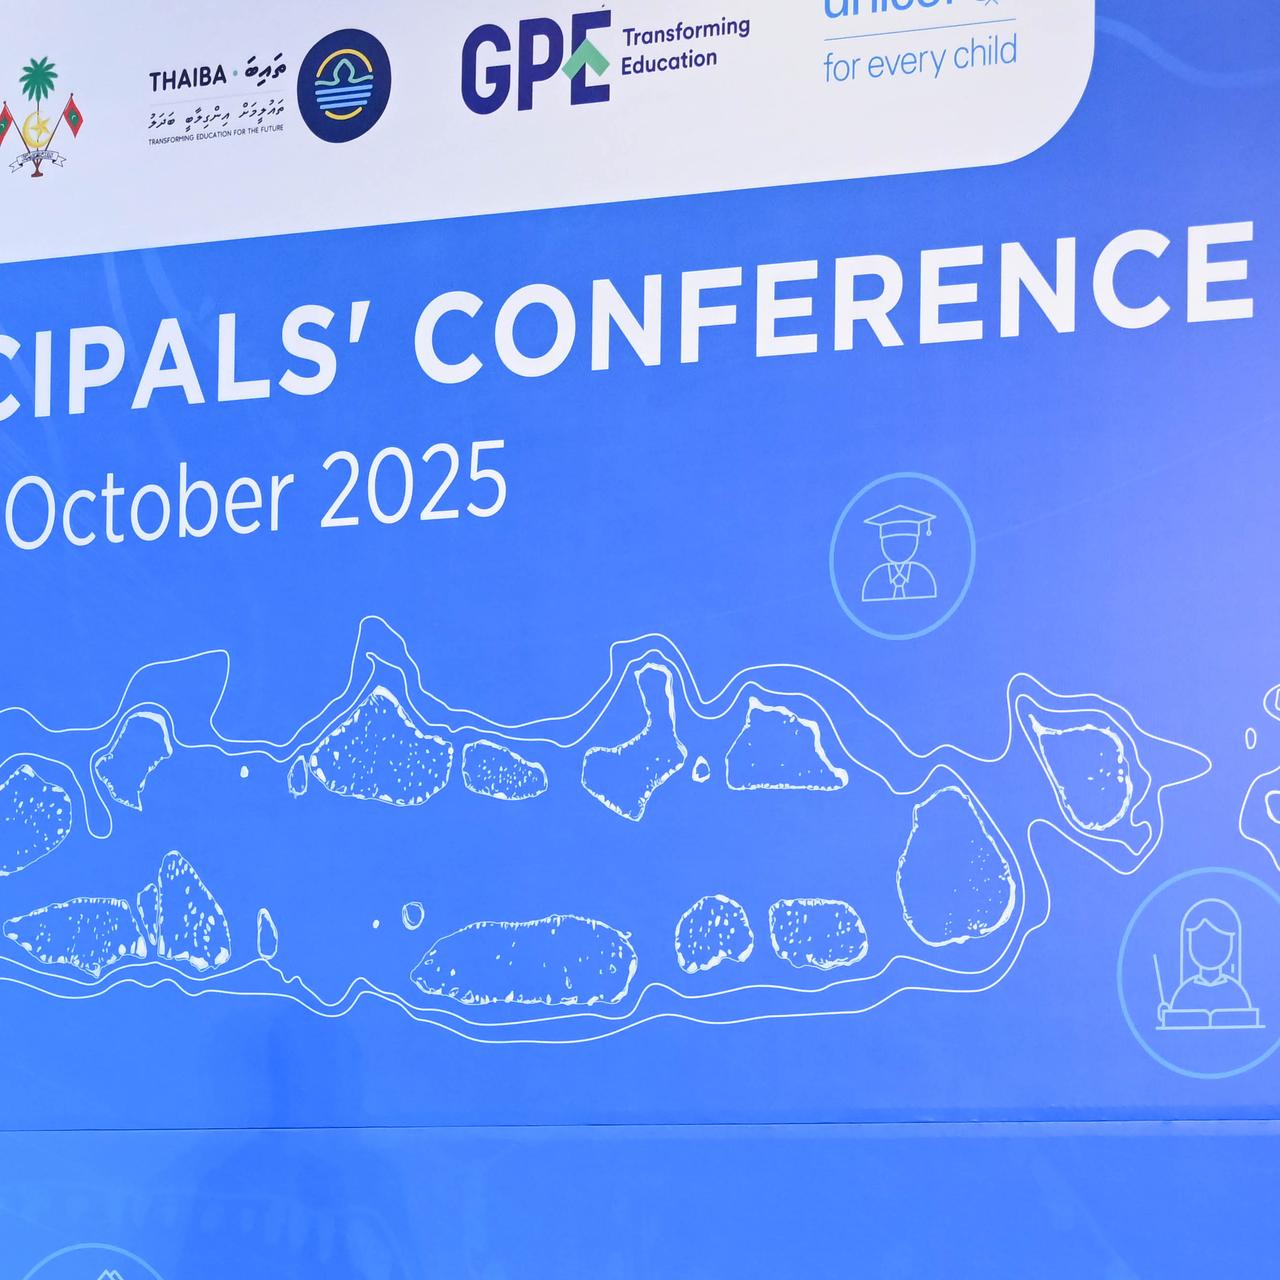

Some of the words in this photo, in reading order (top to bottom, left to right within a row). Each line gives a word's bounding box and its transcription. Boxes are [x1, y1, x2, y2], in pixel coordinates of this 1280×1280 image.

[622, 16, 751, 47] Transforming
[244, 52, 287, 87] ތައިބަ
[461, 9, 612, 115] GPE
[621, 49, 717, 75] Education
[823, 52, 861, 83] for
[867, 49, 947, 79] every
[953, 33, 1017, 69] child
[149, 64, 227, 92] THAIBA
[148, 133, 195, 146] TRANSFORMING
[196, 129, 232, 141] EDUCATION
[233, 127, 246, 136] FOR
[248, 125, 259, 134] THE
[260, 124, 284, 133] FUTURE
[414, 221, 1255, 385] CONFERENCE
[4, 462, 295, 551] October
[320, 439, 507, 529] 2025
